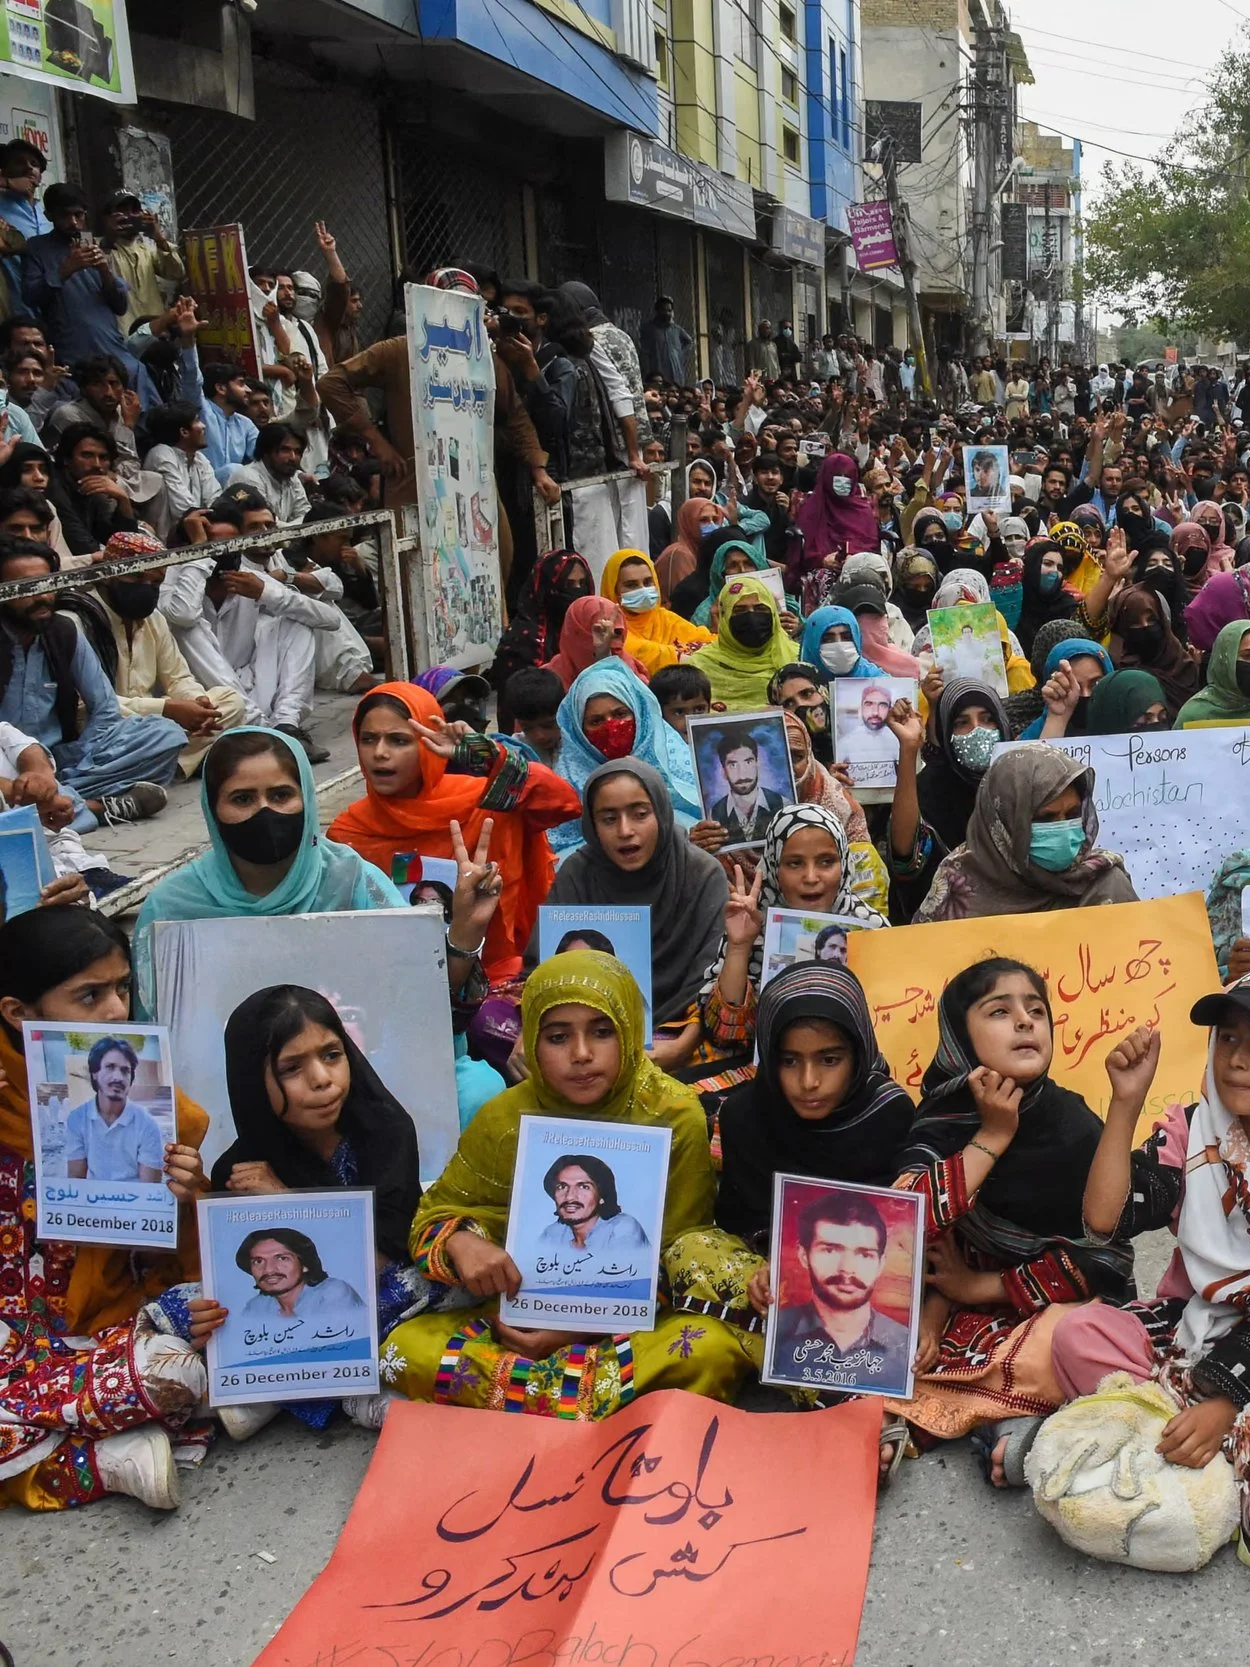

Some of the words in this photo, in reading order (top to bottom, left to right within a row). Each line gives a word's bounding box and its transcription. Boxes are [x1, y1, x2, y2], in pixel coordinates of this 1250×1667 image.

[1096, 769, 1204, 813] alochistan
[1057, 942, 1116, 1003] سال
[543, 1131, 652, 1153] #ReleaseRashidHussain
[45, 1183, 79, 1202] بلوچ
[46, 1212, 63, 1226] 26
[67, 1213, 137, 1230] December
[141, 1218, 174, 1234] 2018
[226, 1206, 351, 1223] #ReleaseRashidHussain
[535, 1252, 560, 1274] بلوچ
[563, 1252, 594, 1275] حسین
[596, 1263, 638, 1277] راشد
[511, 1298, 529, 1310] 26
[533, 1300, 609, 1316] December
[613, 1304, 649, 1318] 2018
[243, 1323, 269, 1346] بلوچ
[273, 1319, 305, 1344] حسین
[311, 1325, 355, 1340] راشد
[220, 1374, 240, 1387] 26
[245, 1368, 328, 1385] December
[332, 1365, 371, 1379] 2018
[801, 1366, 857, 1385] 3.5.2016
